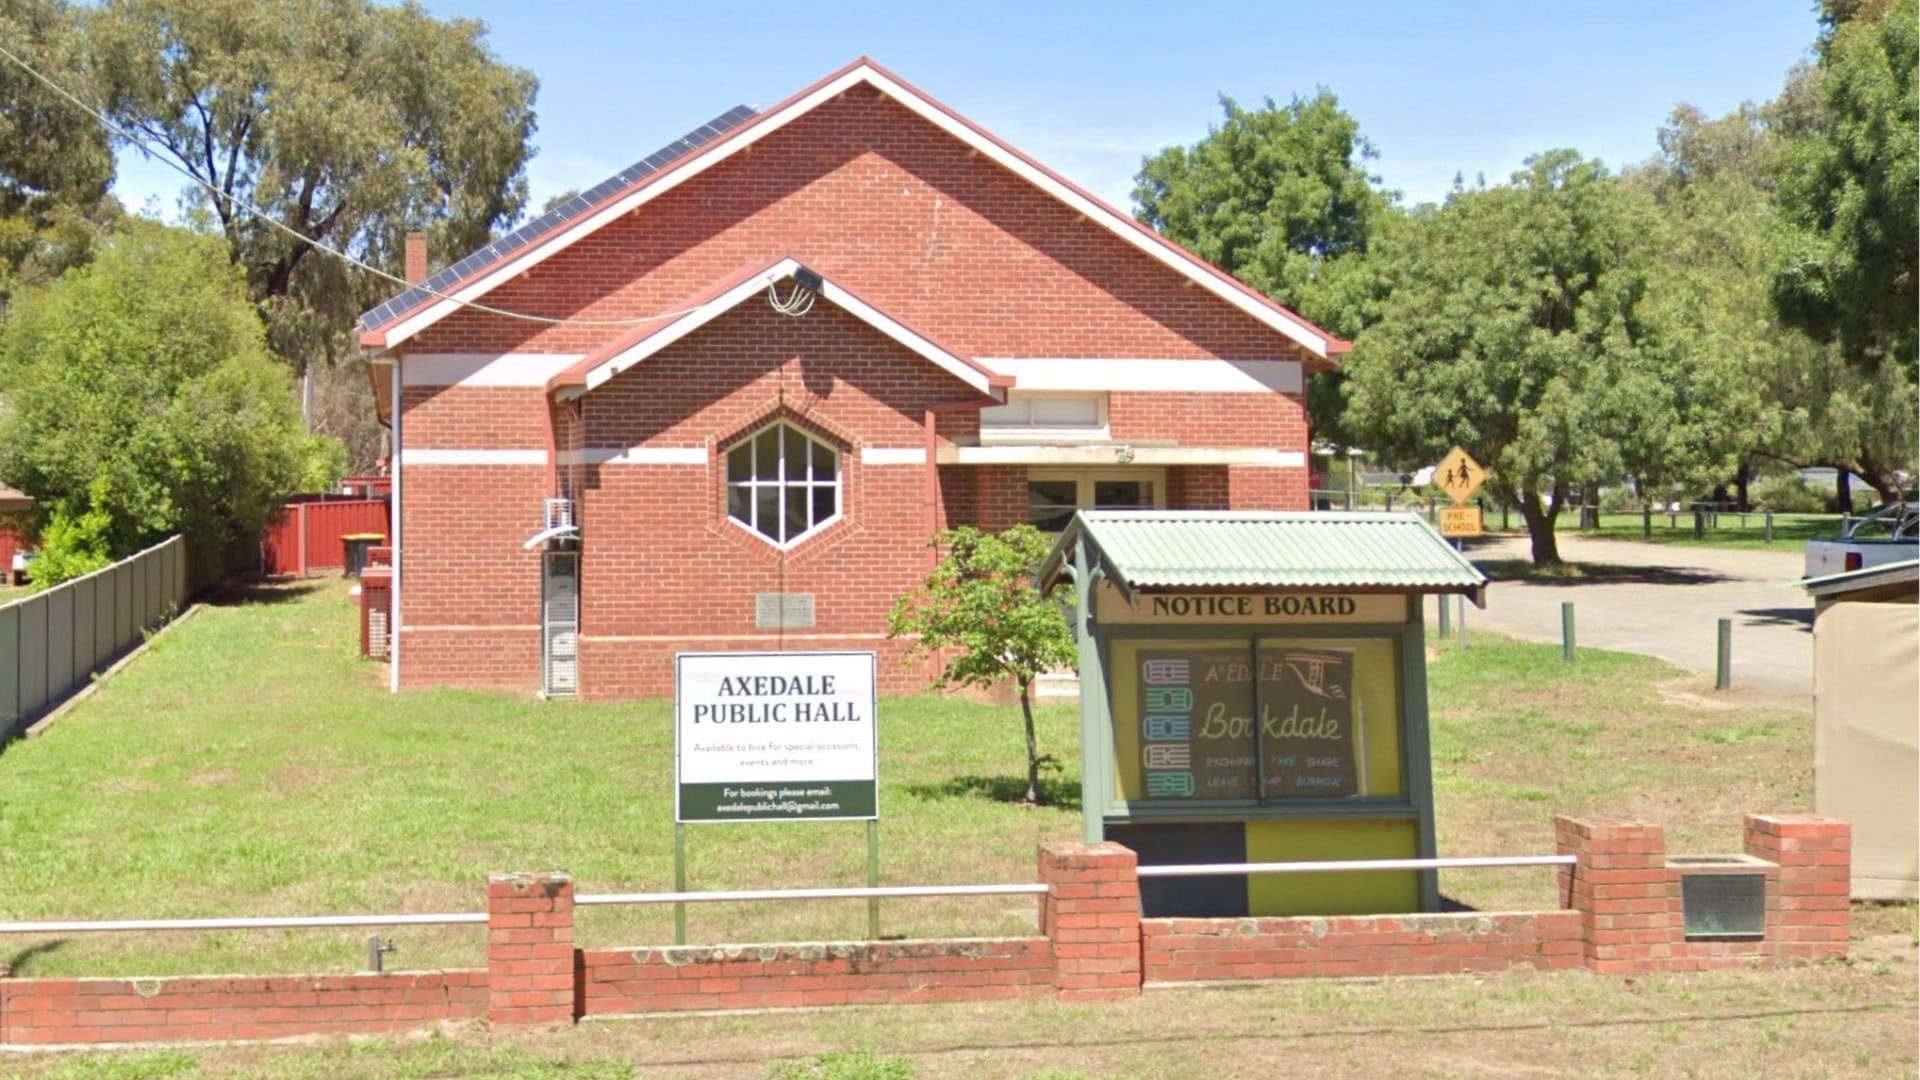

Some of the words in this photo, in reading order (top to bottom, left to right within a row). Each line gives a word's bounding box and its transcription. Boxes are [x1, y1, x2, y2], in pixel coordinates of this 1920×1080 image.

[1153, 596, 1252, 616] NOTICE
[1264, 596, 1356, 616] BOARD
[718, 675, 836, 697] AXEDALE
[694, 703, 787, 724] PUBLIC
[795, 702, 861, 722] HALL
[693, 742, 734, 752] Available
[736, 743, 746, 752] to
[748, 742, 766, 751] hire
[768, 741, 782, 750] for
[784, 742, 815, 753] special
[739, 757, 769, 766] events
[771, 757, 788, 766] and
[723, 787, 740, 798] For
[740, 787, 778, 800] bookings
[778, 786, 805, 799] please
[716, 800, 840, 814] axedalepublichall@gmail.com
